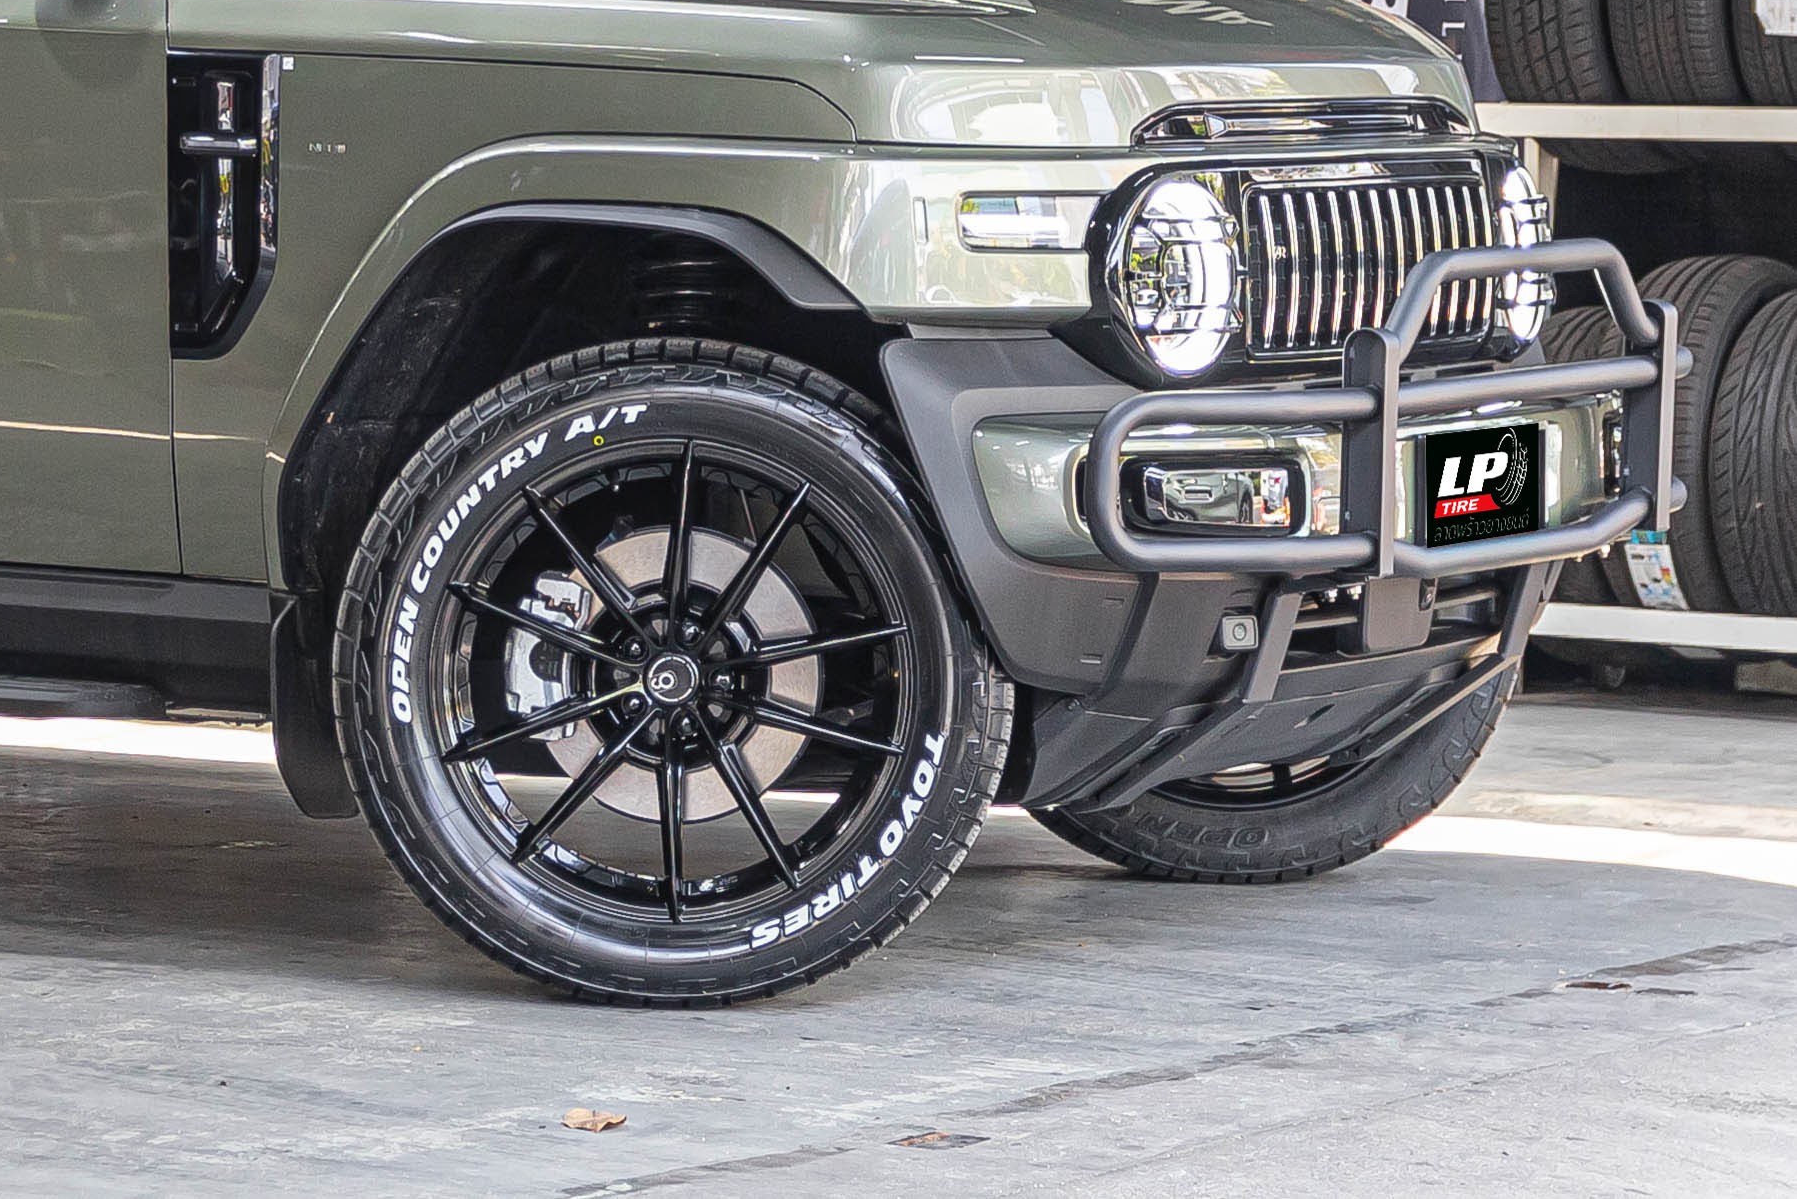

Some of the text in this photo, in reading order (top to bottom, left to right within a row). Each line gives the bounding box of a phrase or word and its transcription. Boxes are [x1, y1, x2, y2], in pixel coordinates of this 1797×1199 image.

[392, 401, 649, 726] OPEN COUNTRY A/T
[748, 729, 949, 952] TOYO TIRES
